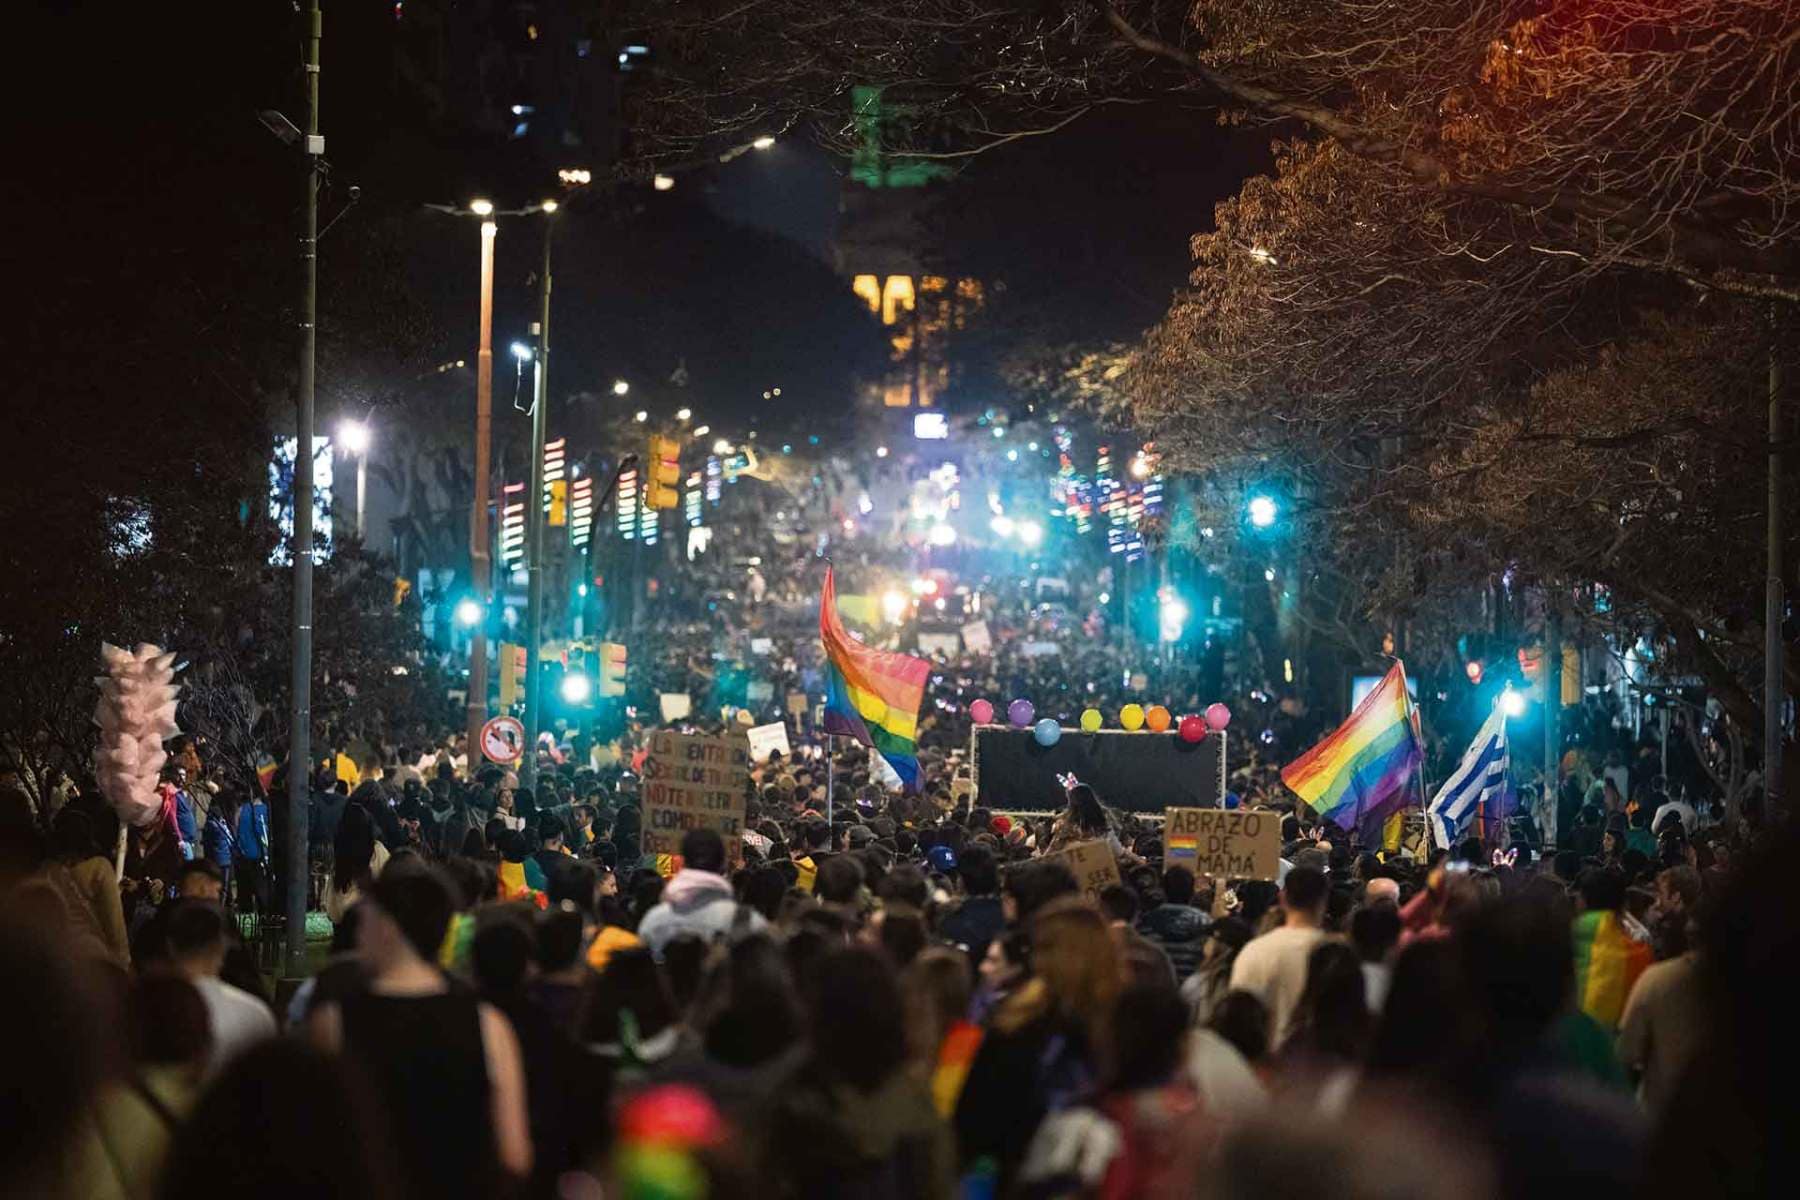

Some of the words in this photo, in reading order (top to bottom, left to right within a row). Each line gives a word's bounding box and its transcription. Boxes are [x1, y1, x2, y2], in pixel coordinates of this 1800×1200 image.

[646, 784, 666, 805] NO
[1171, 811, 1260, 838] ABRAZO
[1208, 835, 1233, 855] DE
[1195, 851, 1256, 873] MAMÁ
